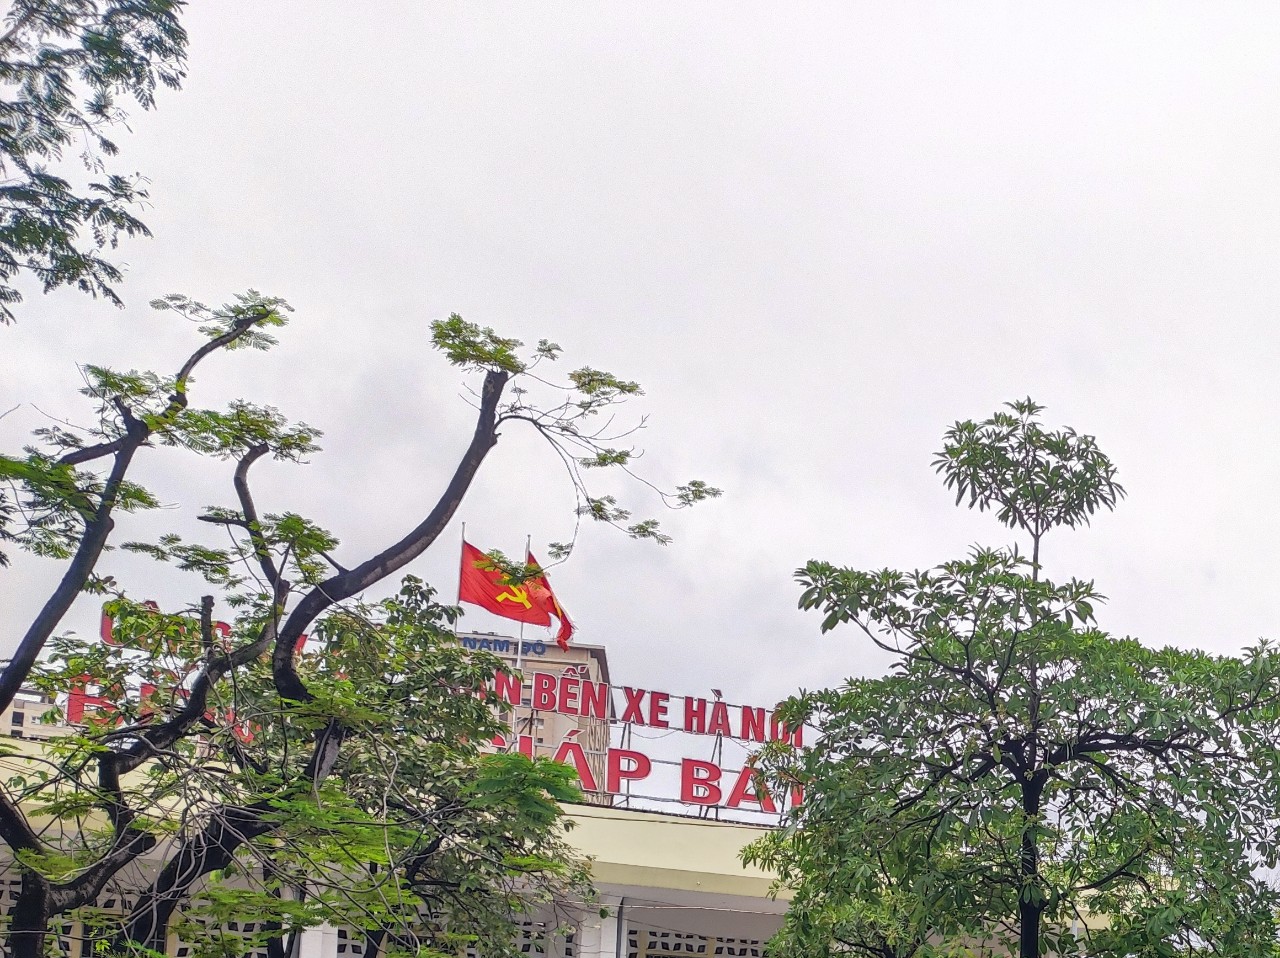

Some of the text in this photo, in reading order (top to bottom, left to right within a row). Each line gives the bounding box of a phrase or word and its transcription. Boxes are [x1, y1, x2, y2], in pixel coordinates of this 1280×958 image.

[532, 666, 608, 720] BẾN
[620, 686, 669, 729] XE
[684, 688, 731, 738] HÀ
